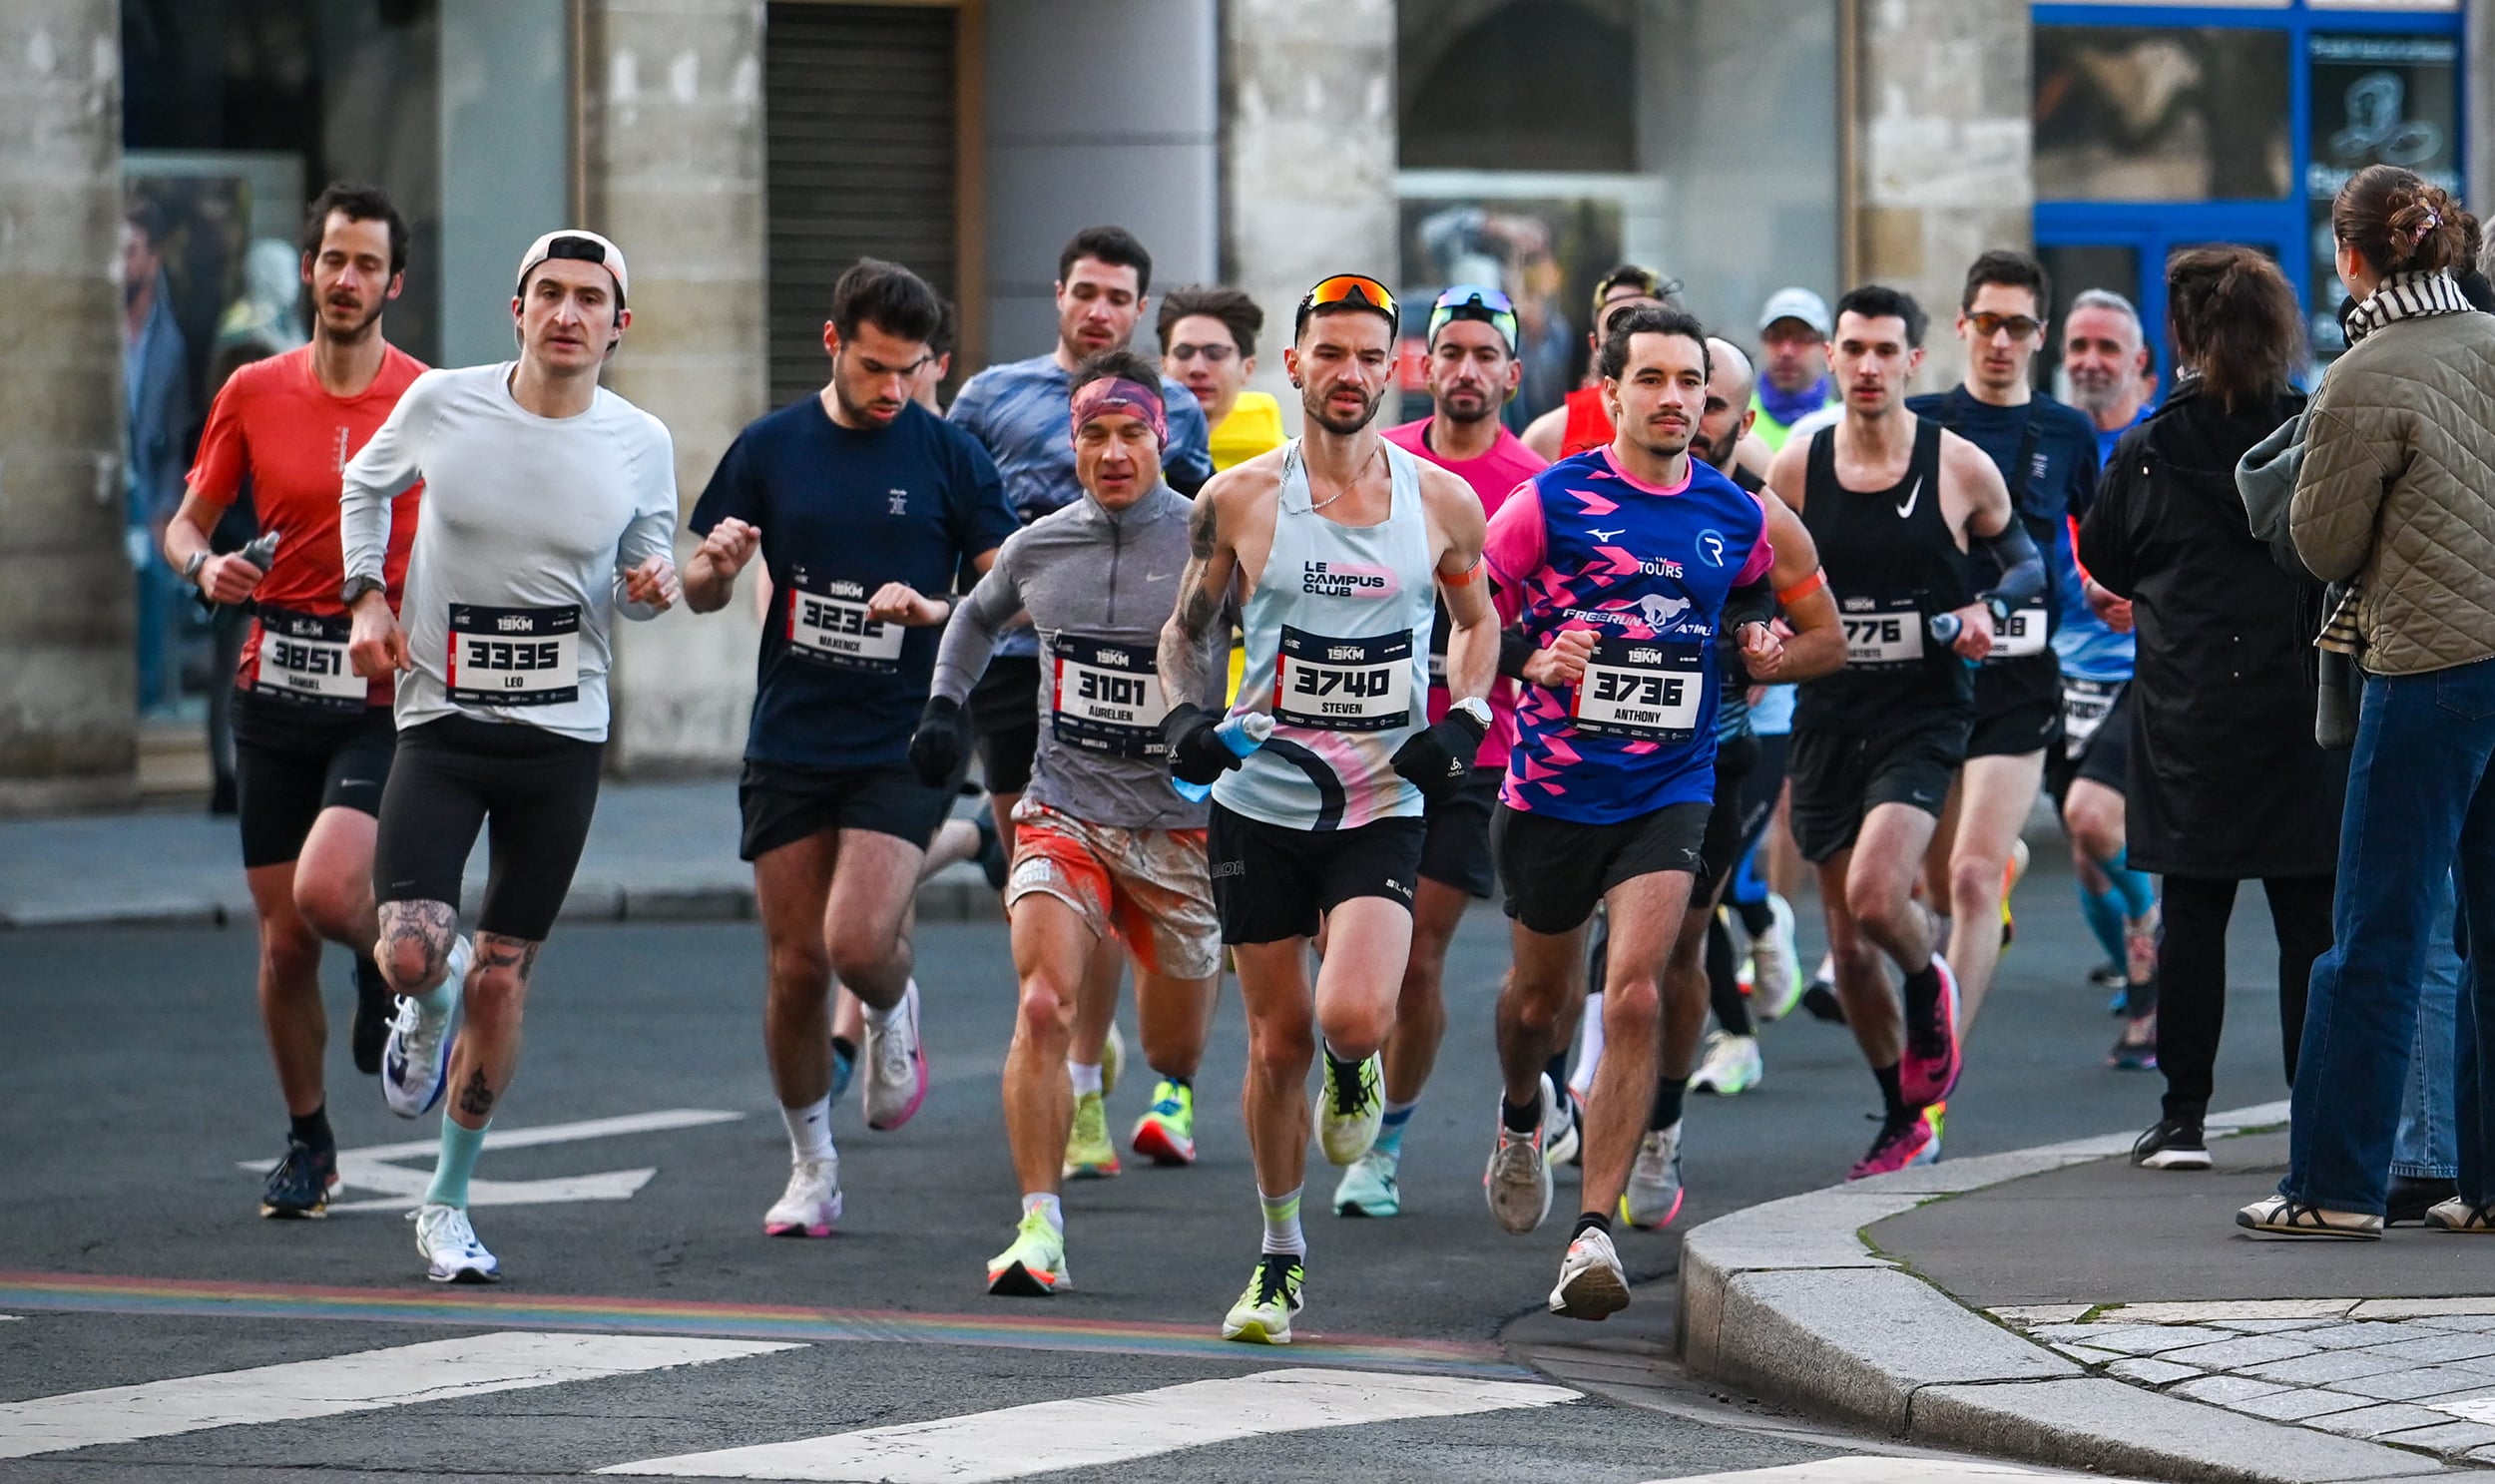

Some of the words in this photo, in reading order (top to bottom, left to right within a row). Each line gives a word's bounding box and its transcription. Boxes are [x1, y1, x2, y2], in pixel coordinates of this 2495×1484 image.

[1303, 561, 1327, 573] LE
[1637, 560, 1684, 579] TOURS
[1302, 573, 1385, 588] CAMPUS
[830, 582, 864, 599] 19KM
[1302, 584, 1352, 597] CLUB
[497, 618, 534, 632] 19KM
[1562, 608, 1643, 628] FREERUN
[818, 635, 862, 653] MAXENCE
[271, 640, 343, 677] 3851
[467, 640, 560, 671] 3335
[1096, 650, 1130, 668] 19KM
[1327, 648, 1365, 661] 19KM
[1628, 650, 1663, 665] 19KM
[504, 676, 524, 689] LEO
[1078, 670, 1147, 708] 3101
[1293, 665, 1390, 699] 3740
[1593, 671, 1685, 707] 3736
[1088, 704, 1134, 723] AURELIEN
[1321, 701, 1363, 715] STEVEN
[1614, 708, 1662, 725] ANTHONY
